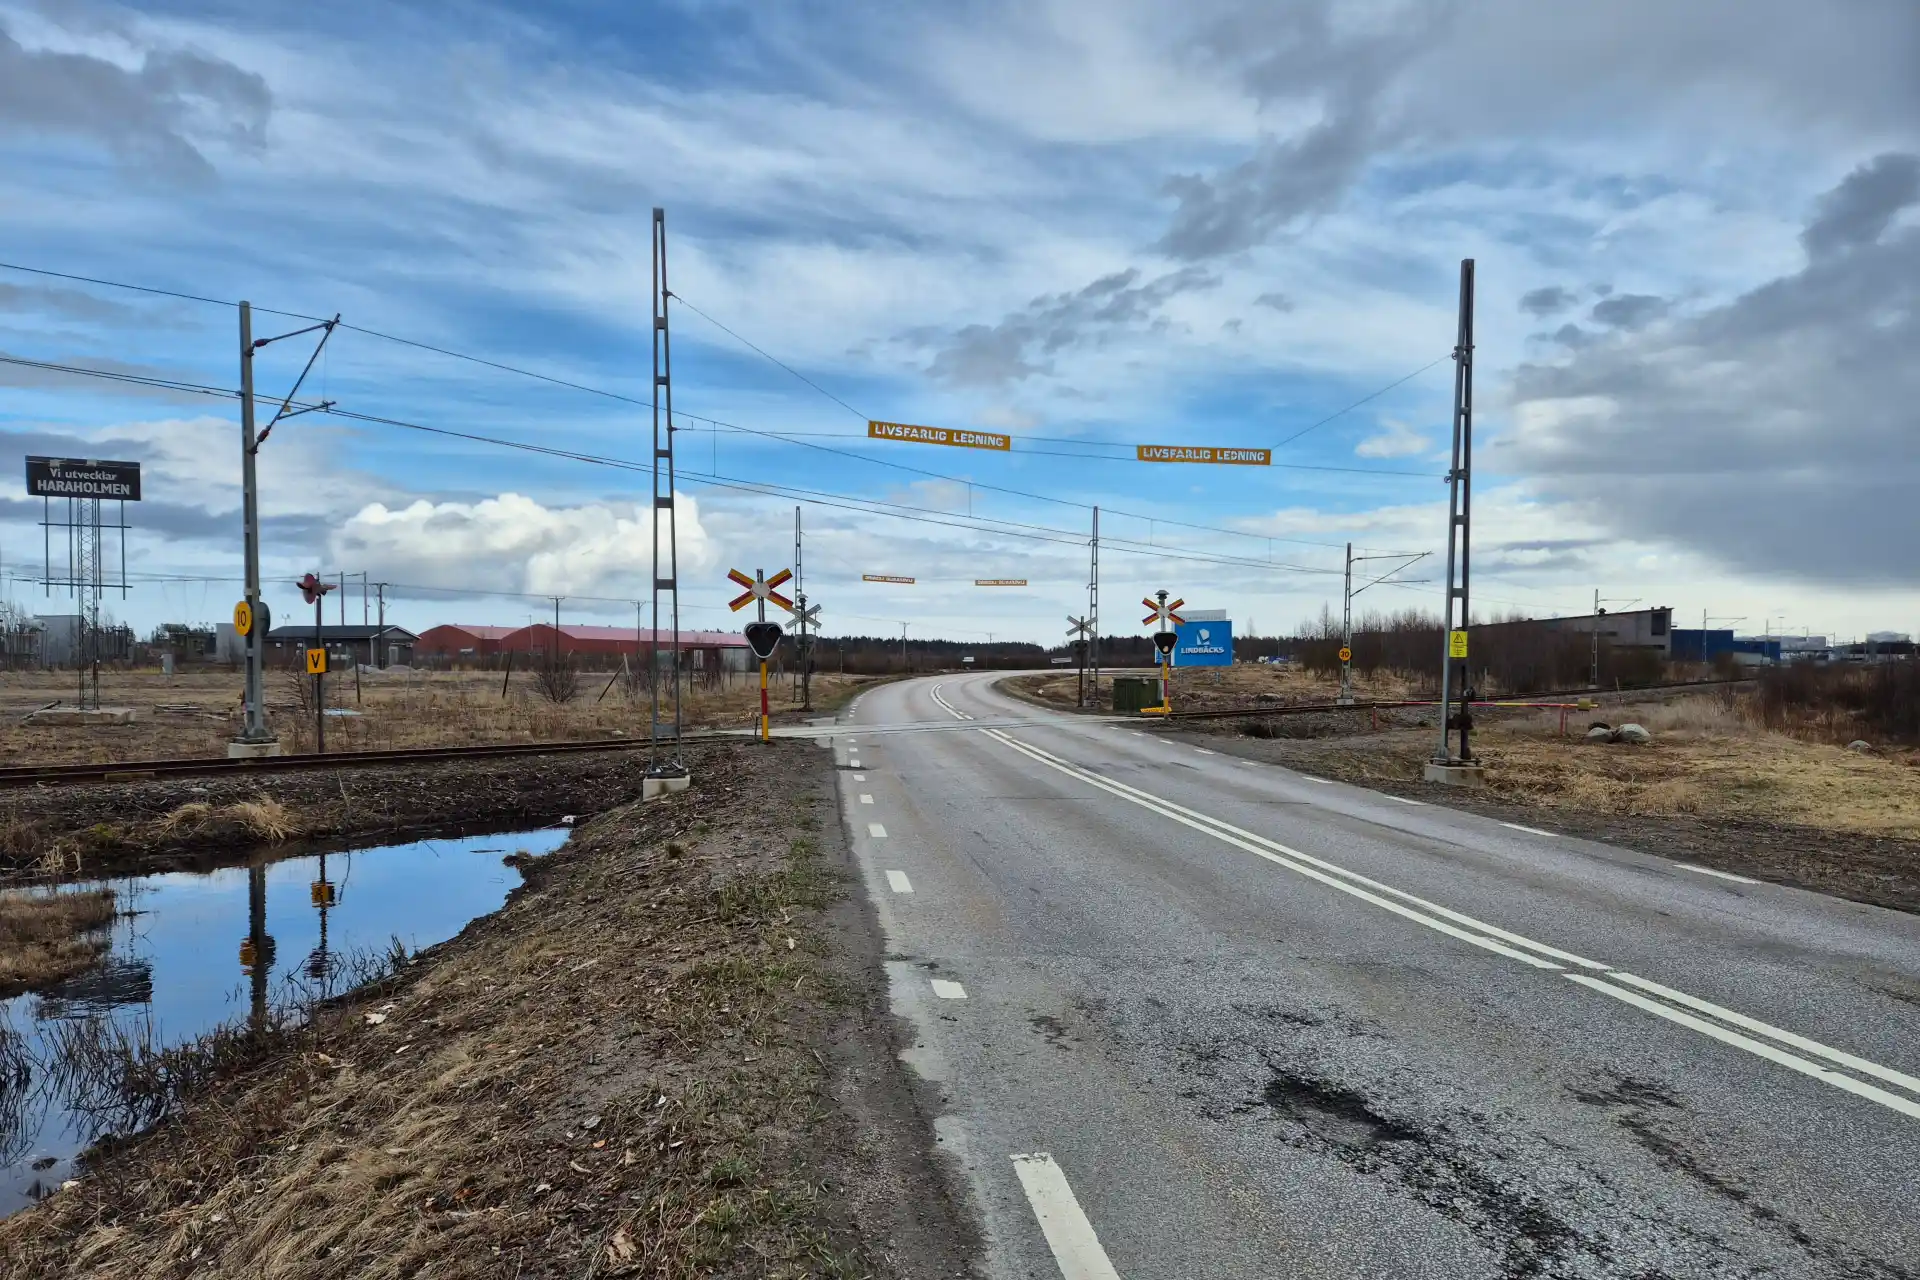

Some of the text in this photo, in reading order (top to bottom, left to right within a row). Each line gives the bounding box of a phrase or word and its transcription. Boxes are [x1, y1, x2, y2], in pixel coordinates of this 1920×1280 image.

[874, 423, 1004, 447] LIVSFARLIG LEDNING
[1143, 447, 1265, 461] LIVSFARLIG LEDNING
[49, 467, 117, 481] Vi utvecklar
[37, 479, 130, 495] HARAHOLMEN
[237, 610, 247, 627] 10
[311, 653, 321, 669] V
